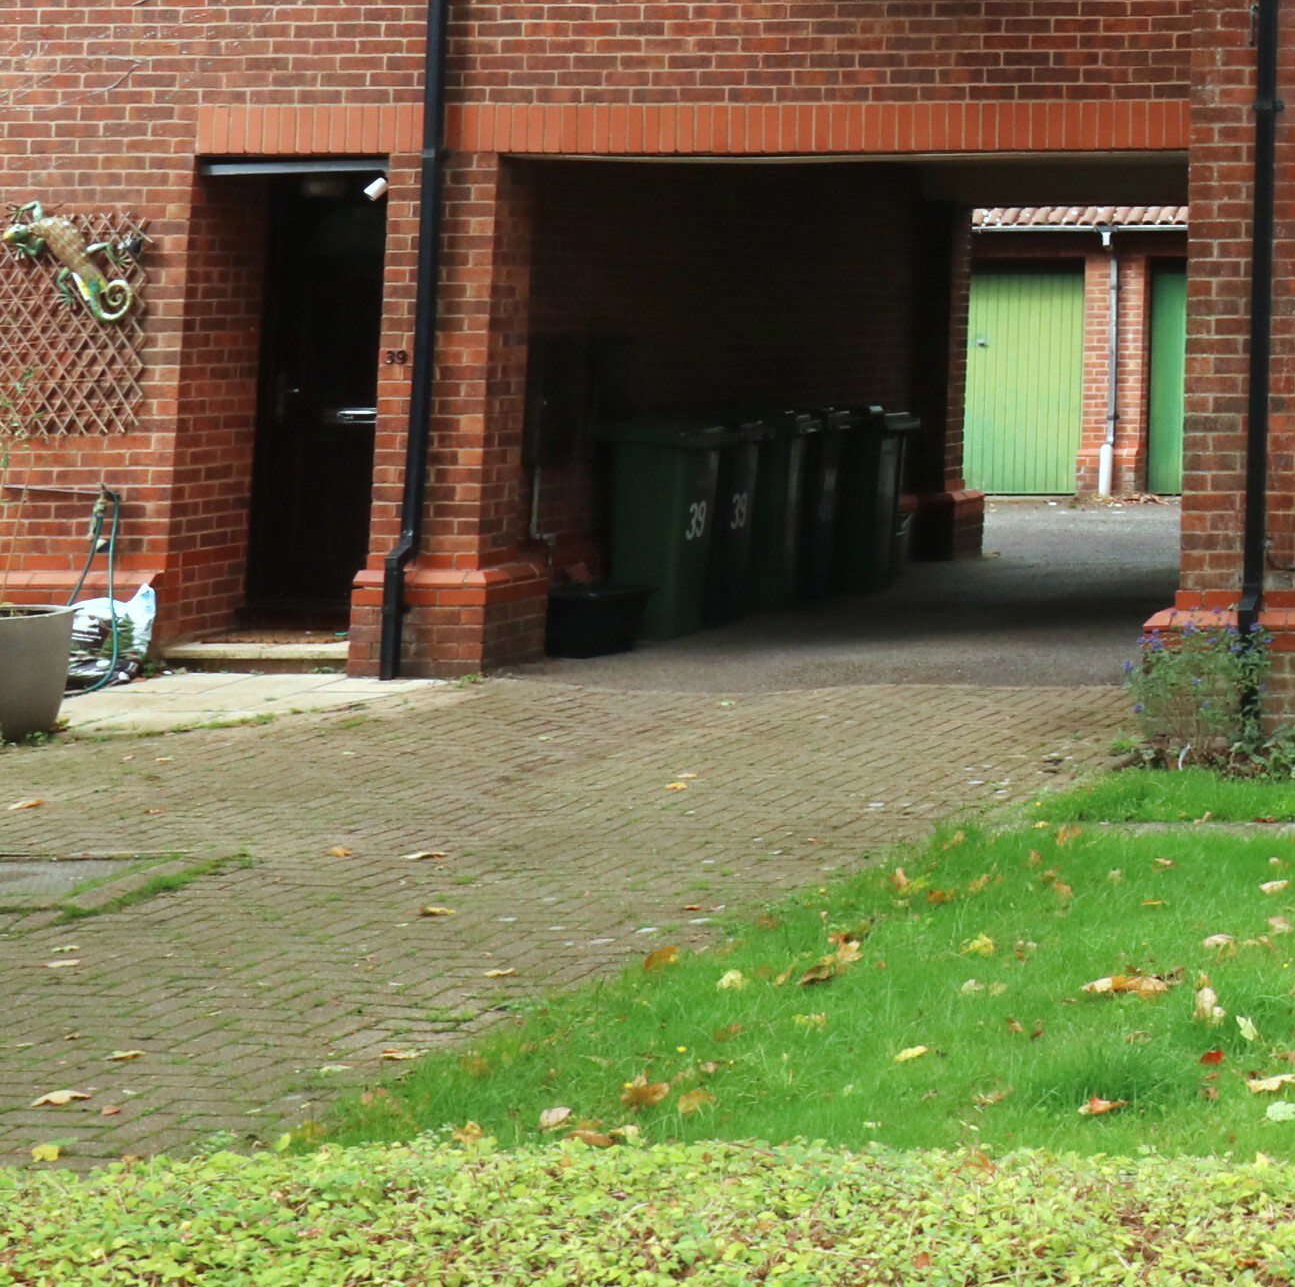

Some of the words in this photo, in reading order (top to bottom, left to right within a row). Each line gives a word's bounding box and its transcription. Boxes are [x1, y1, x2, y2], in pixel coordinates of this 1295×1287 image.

[384, 350, 408, 364] 39
[685, 500, 708, 540] 39
[730, 491, 748, 530] 39
